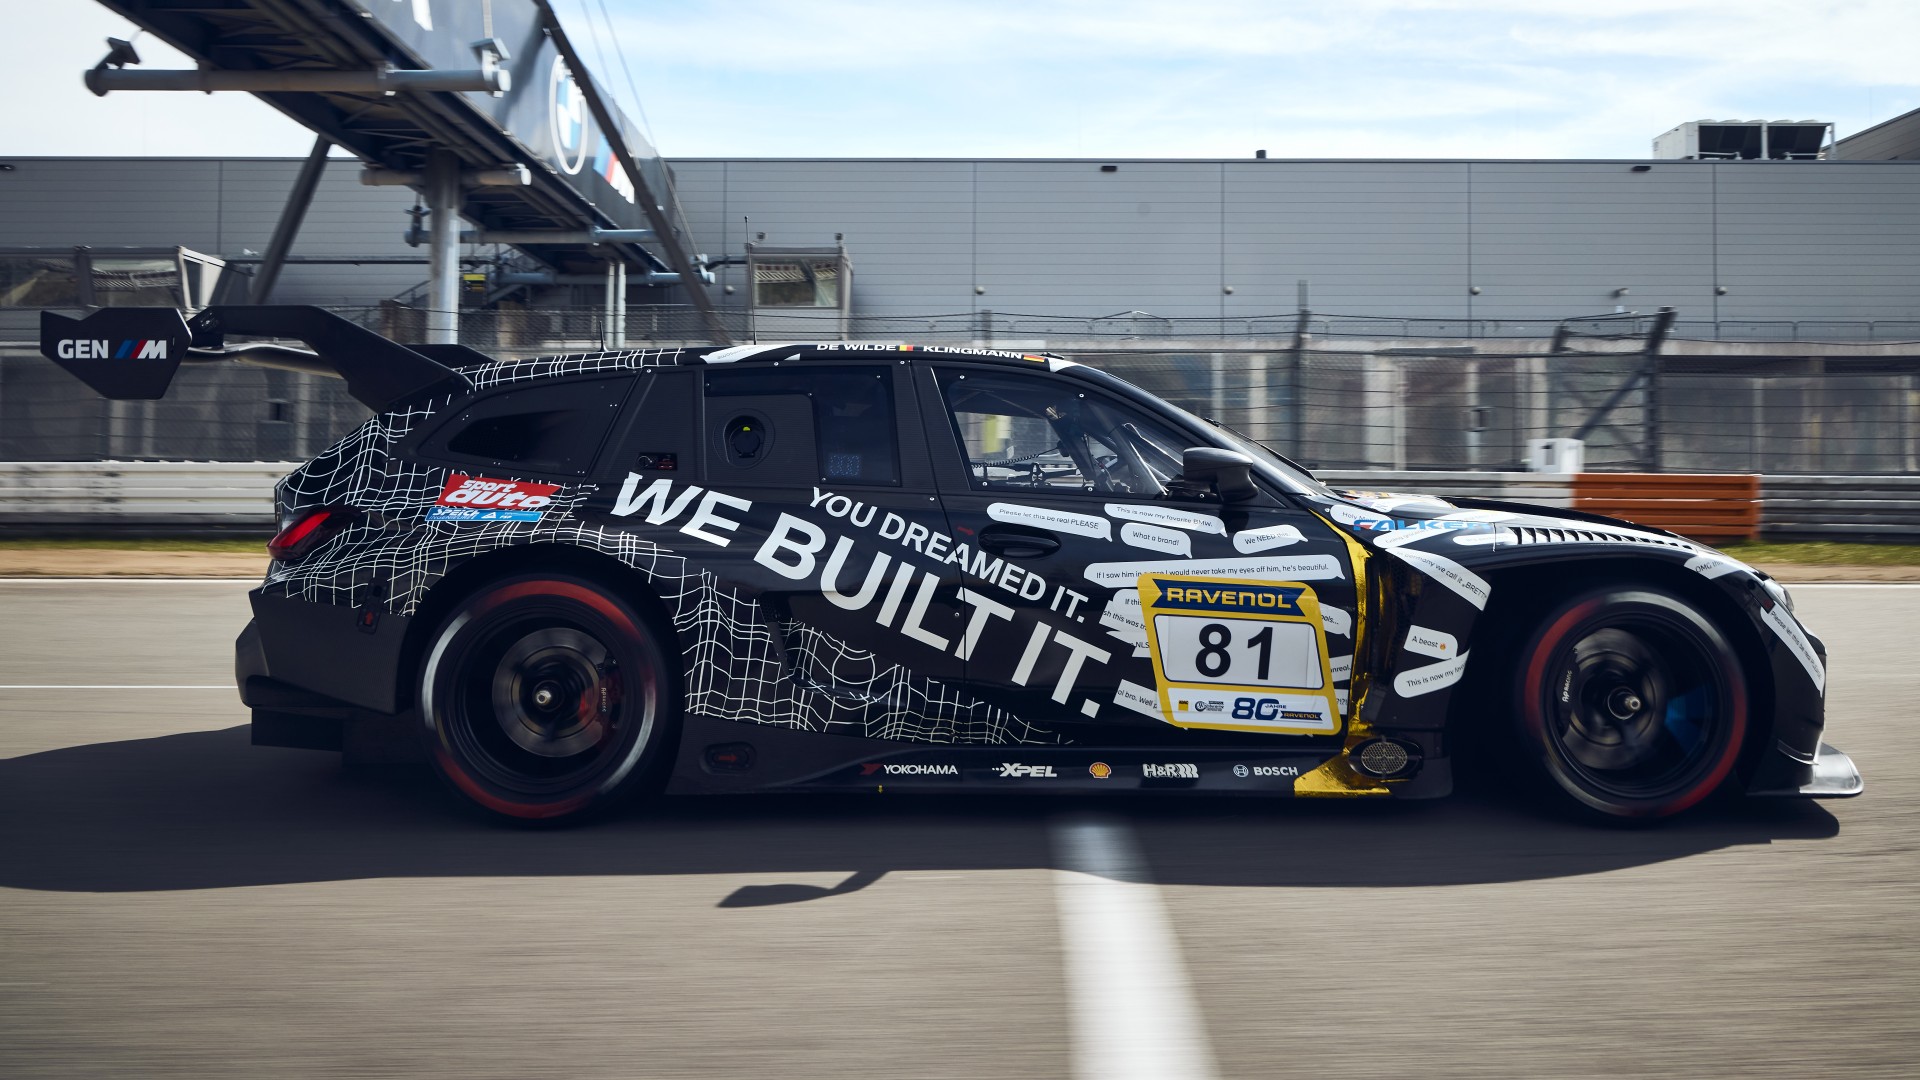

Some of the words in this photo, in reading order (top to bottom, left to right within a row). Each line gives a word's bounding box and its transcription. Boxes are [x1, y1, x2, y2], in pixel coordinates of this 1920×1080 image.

[57, 339, 109, 359] GEN
[136, 339, 167, 359] M
[923, 345, 1023, 359] KLINGMANN
[458, 479, 518, 493] sport
[444, 488, 551, 508] auto
[998, 508, 1022, 517] Please
[1070, 518, 1099, 530] PLEASE
[1116, 506, 1131, 514] This
[1166, 514, 1192, 524] favorite
[1342, 511, 1358, 520] Holy
[1132, 530, 1151, 540] What
[1157, 535, 1180, 546] brand!
[1244, 537, 1256, 545] We
[1256, 534, 1276, 543] NEED
[808, 487, 879, 529] YOU
[878, 511, 1046, 601] DREAMED
[1050, 585, 1089, 623] IT.
[1297, 563, 1329, 571] beautiful.
[1435, 563, 1446, 574] we
[1445, 570, 1458, 581] call
[1457, 575, 1463, 584] it
[610, 471, 752, 547] WE
[754, 511, 1014, 662] BUILT
[1011, 621, 1112, 719] IT.
[1167, 587, 1292, 609] RAVENOL
[1112, 612, 1125, 622] this
[1125, 619, 1139, 628] was
[1411, 635, 1418, 643] A
[1418, 637, 1439, 648] beast
[1195, 623, 1273, 680] 81
[1406, 678, 1422, 687] This
[1429, 672, 1444, 682] now
[1444, 669, 1454, 677] my
[1124, 690, 1137, 701] bro.
[1138, 695, 1153, 706] Well
[1231, 697, 1280, 721] 80
[883, 764, 959, 775] YOKOHAMA
[999, 763, 1058, 778] XPEL
[1252, 766, 1299, 777] BOSCH
